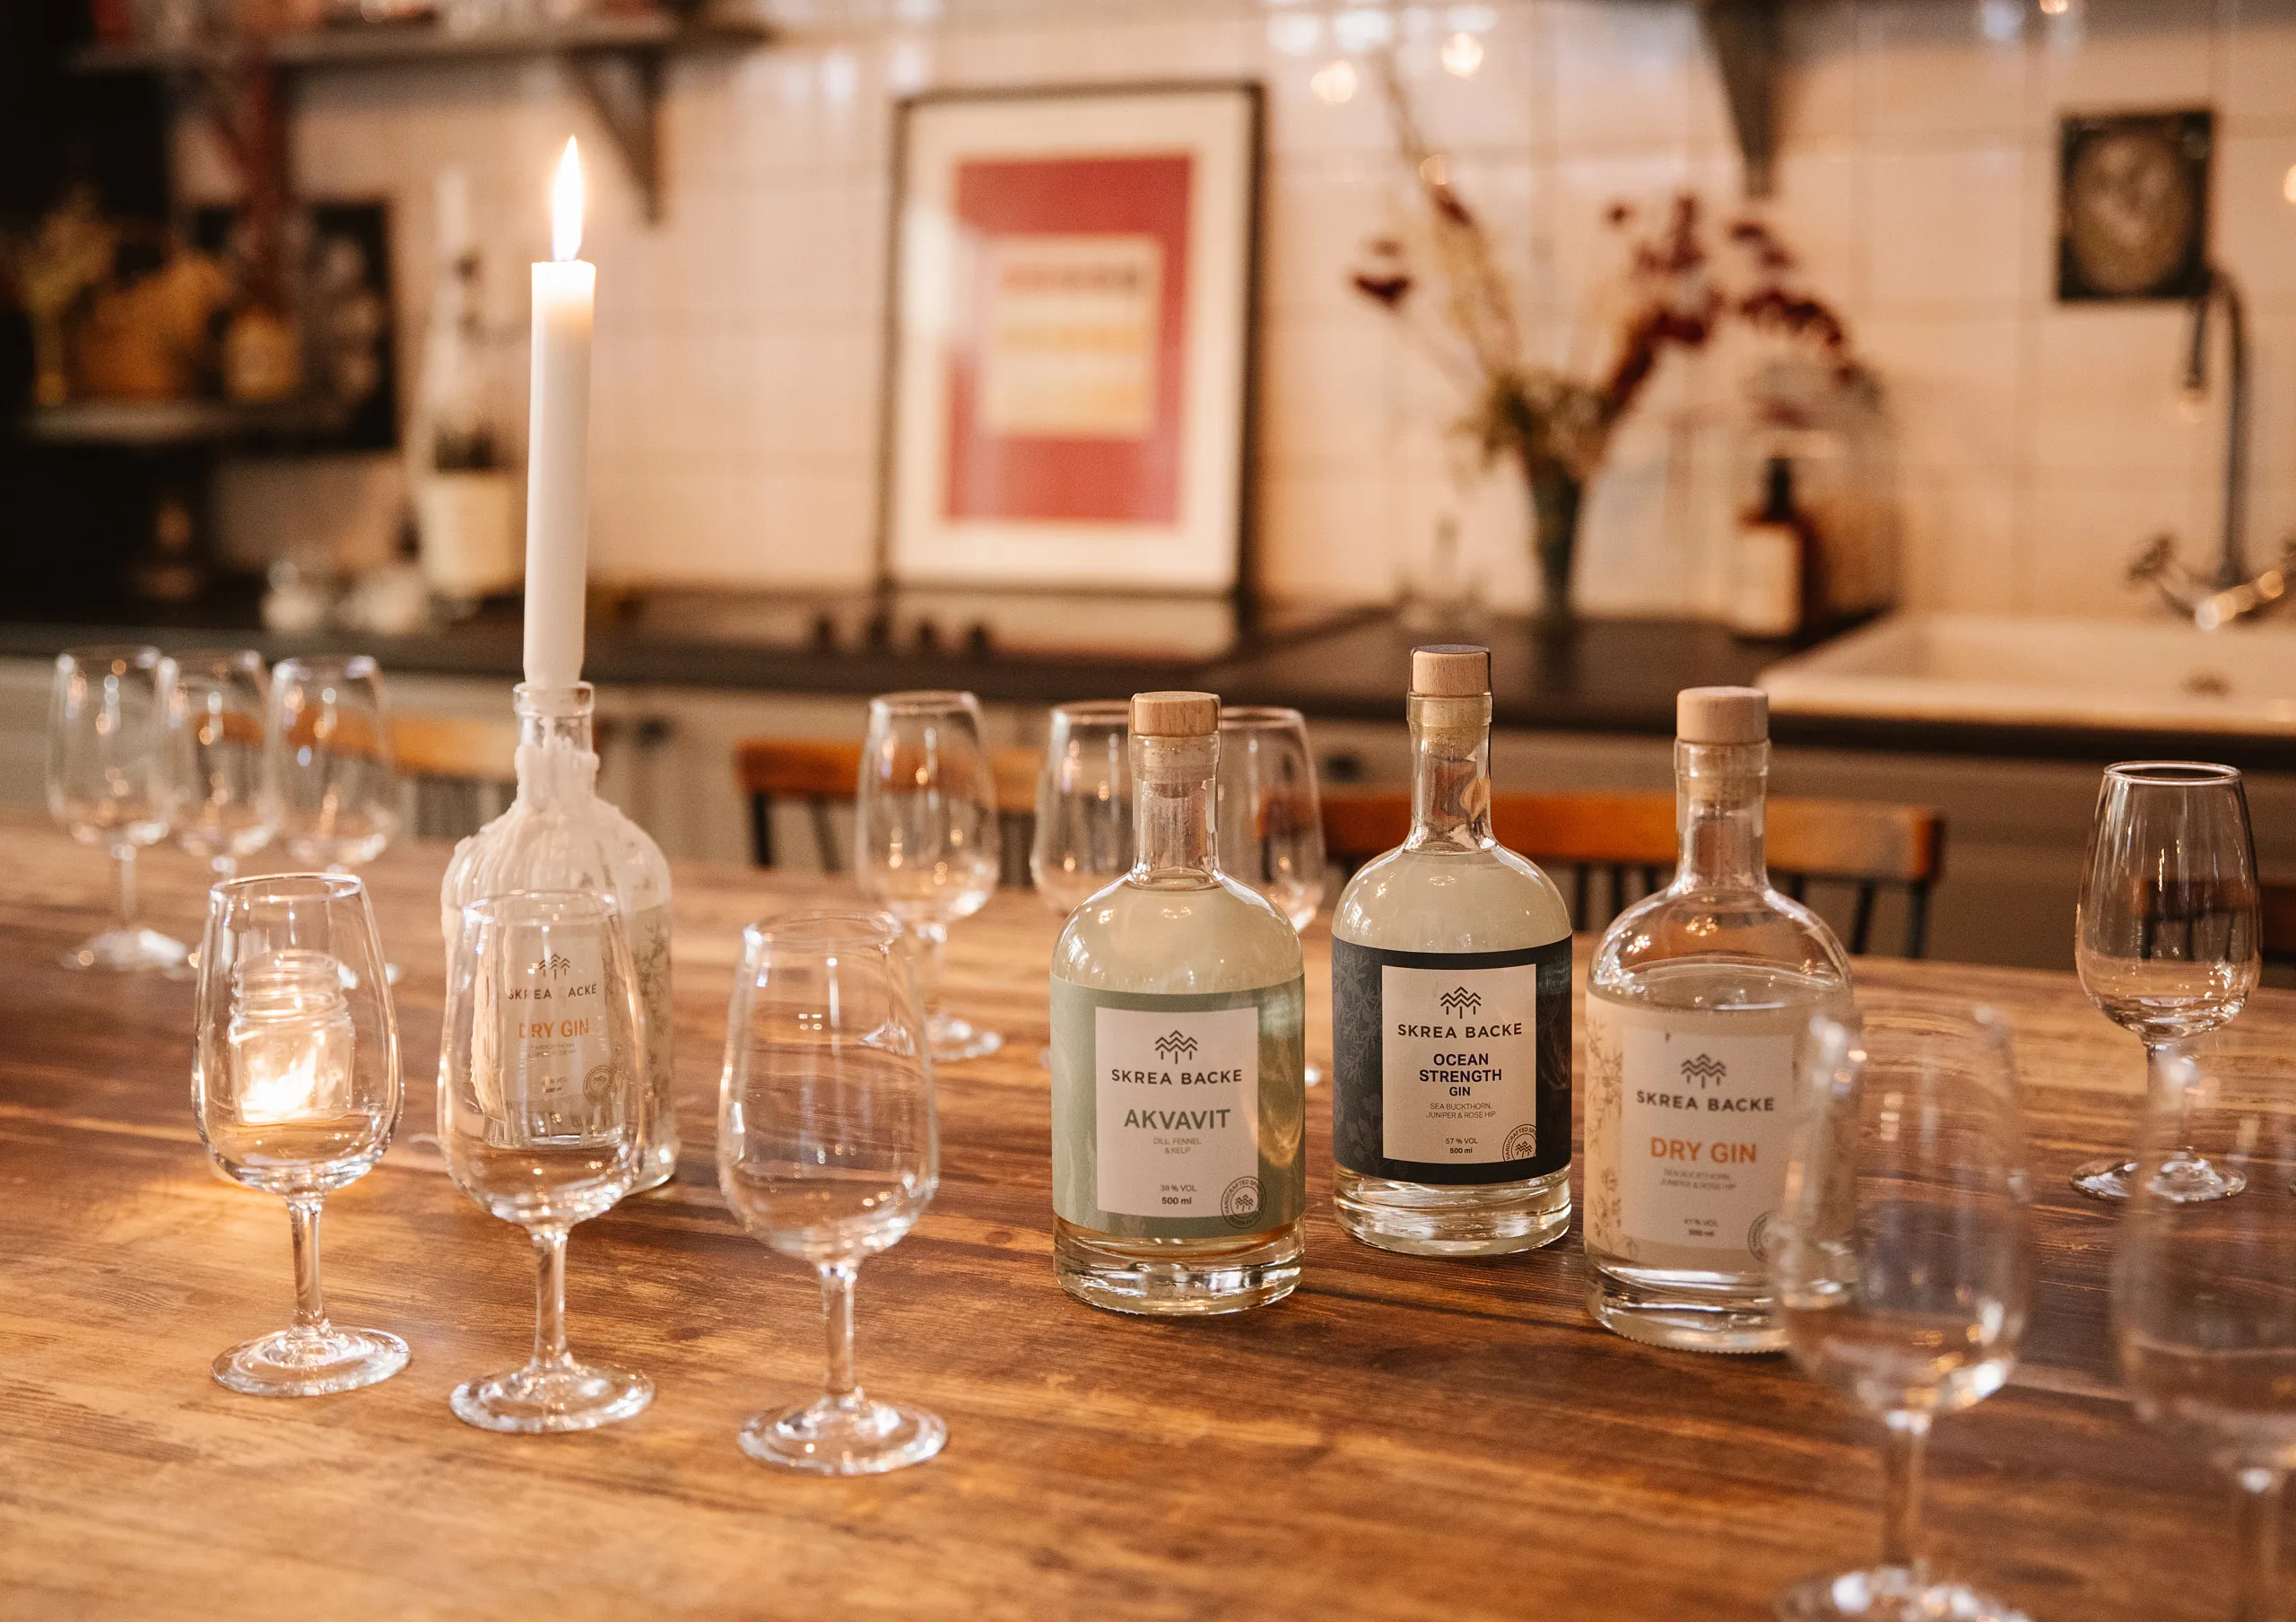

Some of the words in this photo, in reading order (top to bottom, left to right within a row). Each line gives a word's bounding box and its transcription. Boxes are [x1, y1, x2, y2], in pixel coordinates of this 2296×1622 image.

[559, 983, 597, 998] ACKE
[561, 1017, 590, 1038] GIN
[1397, 1024, 1457, 1039] SKREA
[1465, 1022, 1523, 1039] BACKE
[1432, 1052, 1490, 1067] OCEAN
[1111, 1068, 1172, 1086] SKREA
[1180, 1068, 1243, 1086] BACKE
[1419, 1068, 1503, 1083] STRENGTH
[1448, 1086, 1472, 1097] GIN
[1635, 1090, 1699, 1111] SKREA
[1707, 1096, 1776, 1112] BACKE
[1123, 1108, 1231, 1130] AKVAVIT
[1649, 1136, 1703, 1163] DRY
[1709, 1141, 1759, 1164] GIN
[1179, 1184, 1197, 1192] VOL
[1161, 1197, 1179, 1205] 500
[1180, 1197, 1193, 1205] ml
